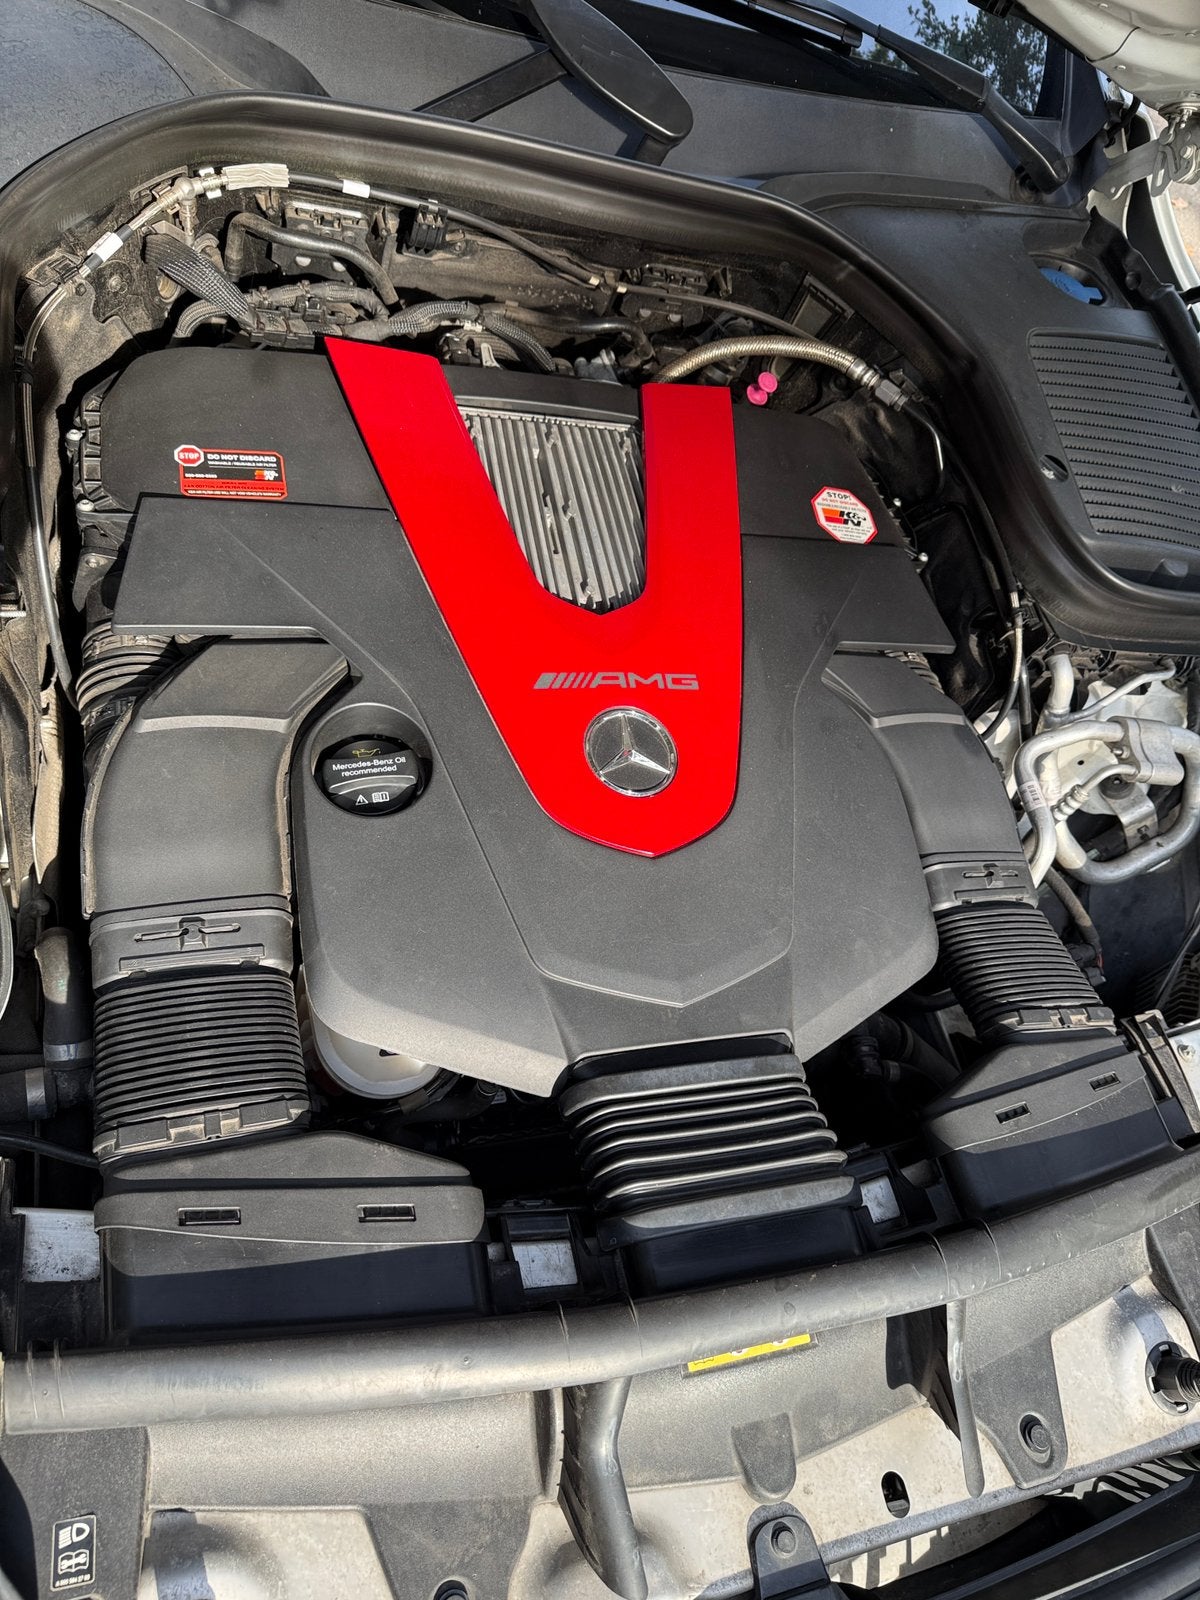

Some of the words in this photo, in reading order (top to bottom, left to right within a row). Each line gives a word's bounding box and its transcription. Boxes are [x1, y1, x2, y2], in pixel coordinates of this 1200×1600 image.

[179, 451, 200, 460] STOP
[332, 758, 393, 771] Mercedes-Benz
[341, 765, 397, 777] recommended
